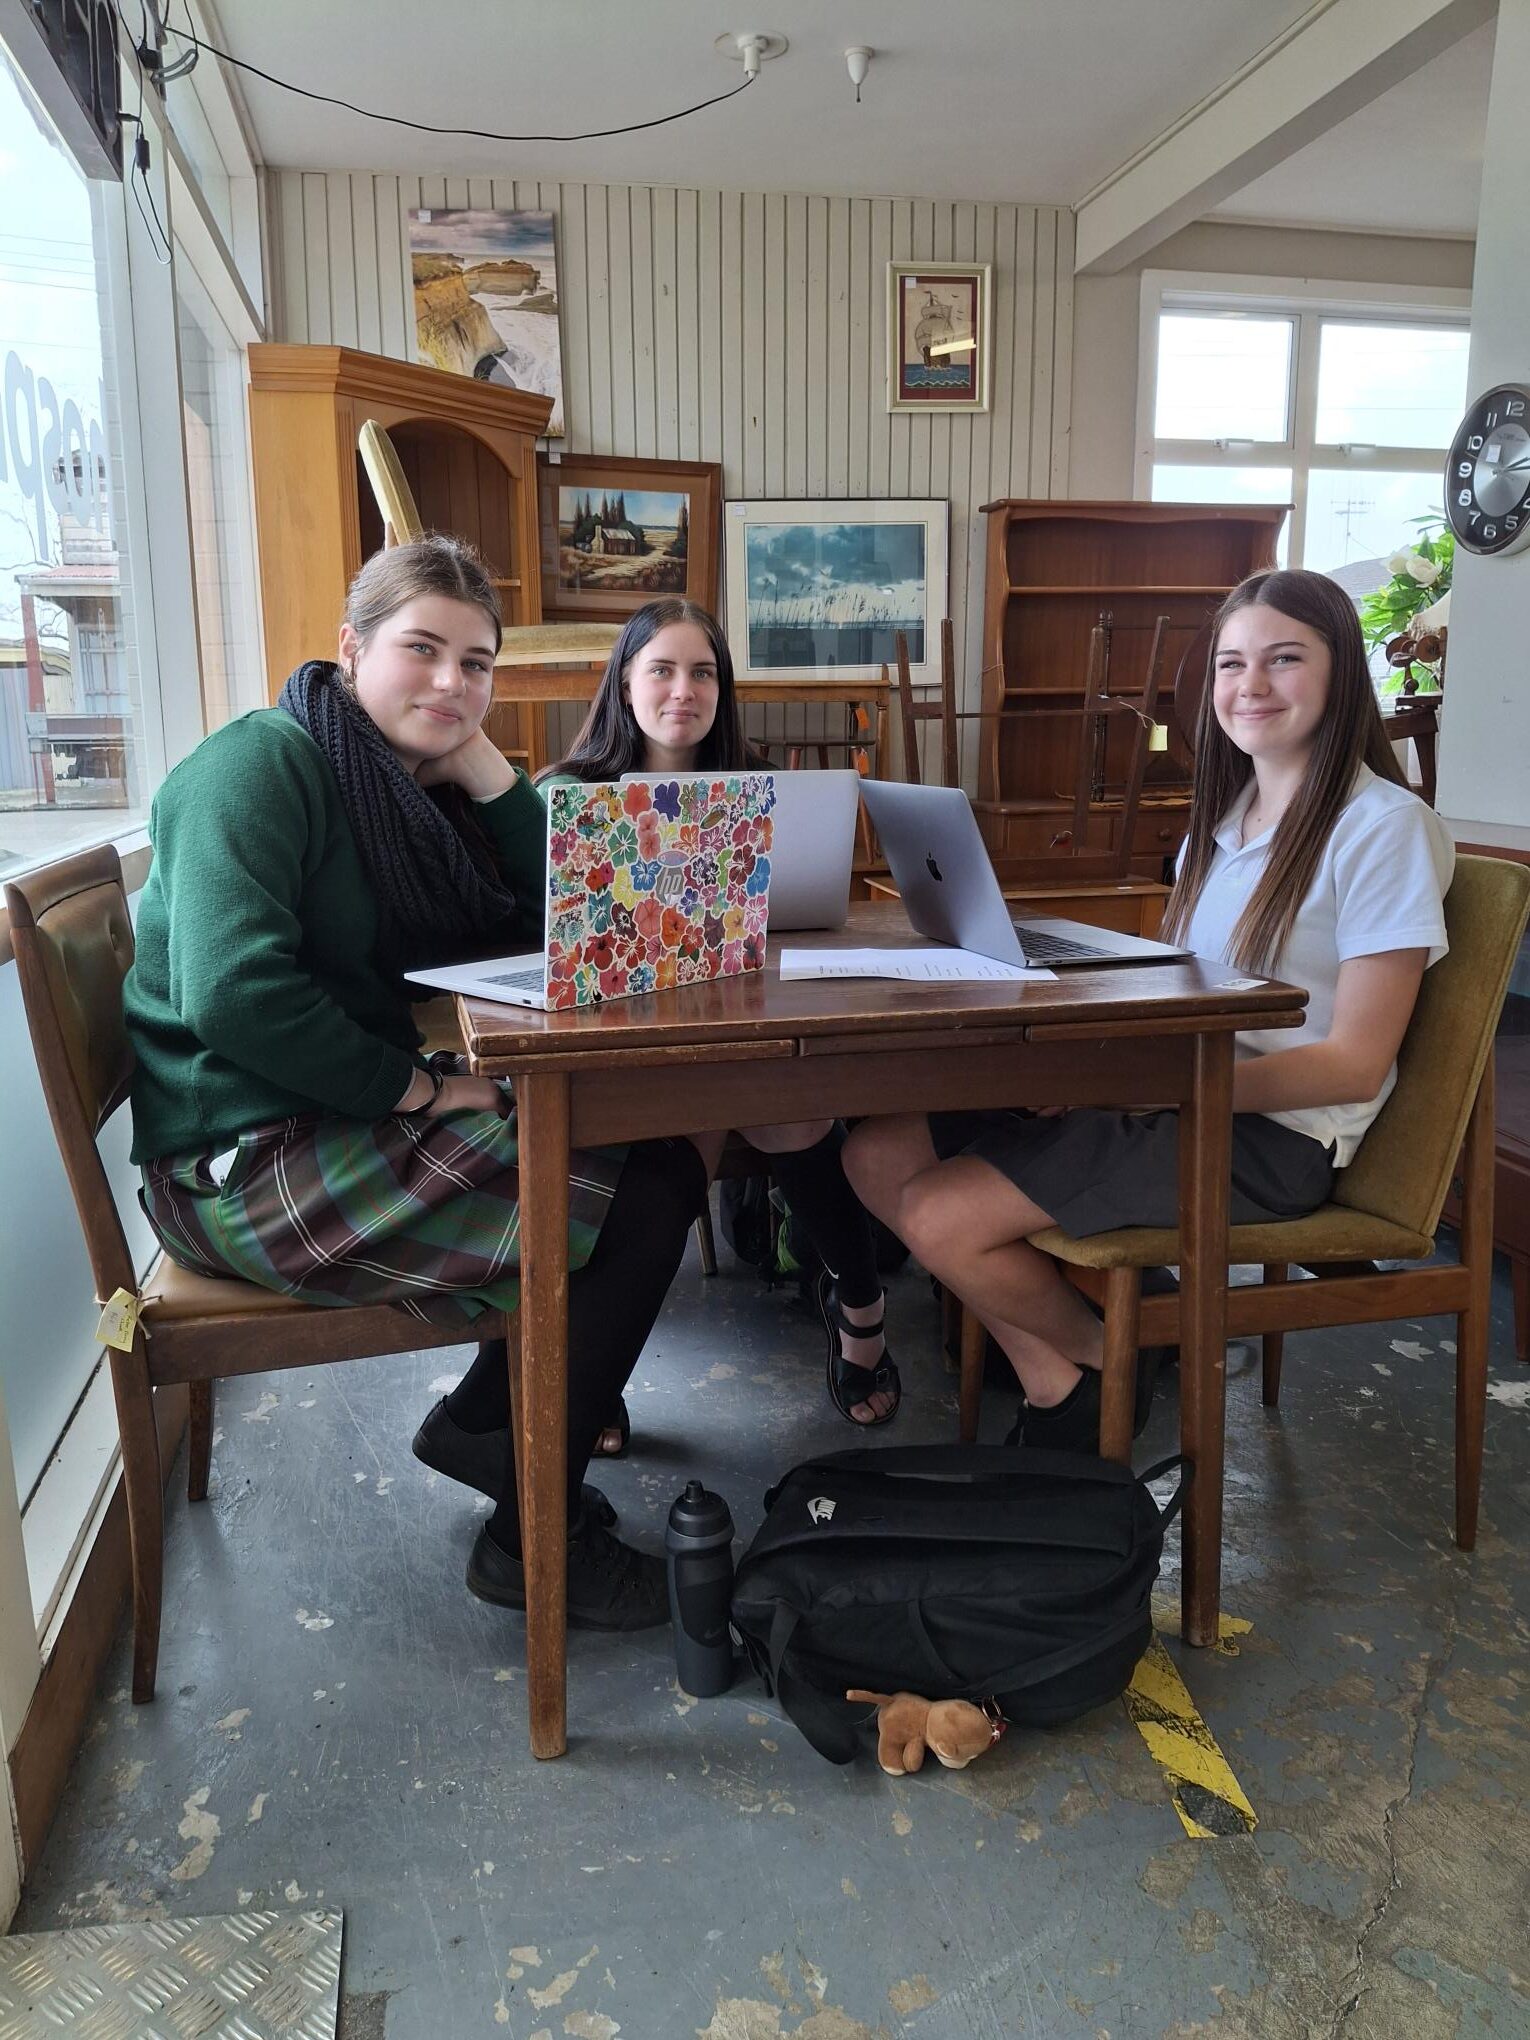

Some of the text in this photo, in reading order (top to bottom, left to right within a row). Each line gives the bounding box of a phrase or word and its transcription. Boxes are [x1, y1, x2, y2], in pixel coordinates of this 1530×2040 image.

[1506, 401, 1525, 417] 12
[1486, 412, 1498, 427] 11
[1467, 435, 1483, 450] 10
[1459, 462, 1472, 478] 9
[1459, 488, 1472, 507] 8
[1469, 510, 1481, 525] 7
[1505, 515, 1519, 530] 5
[1484, 524, 1497, 539] 6
